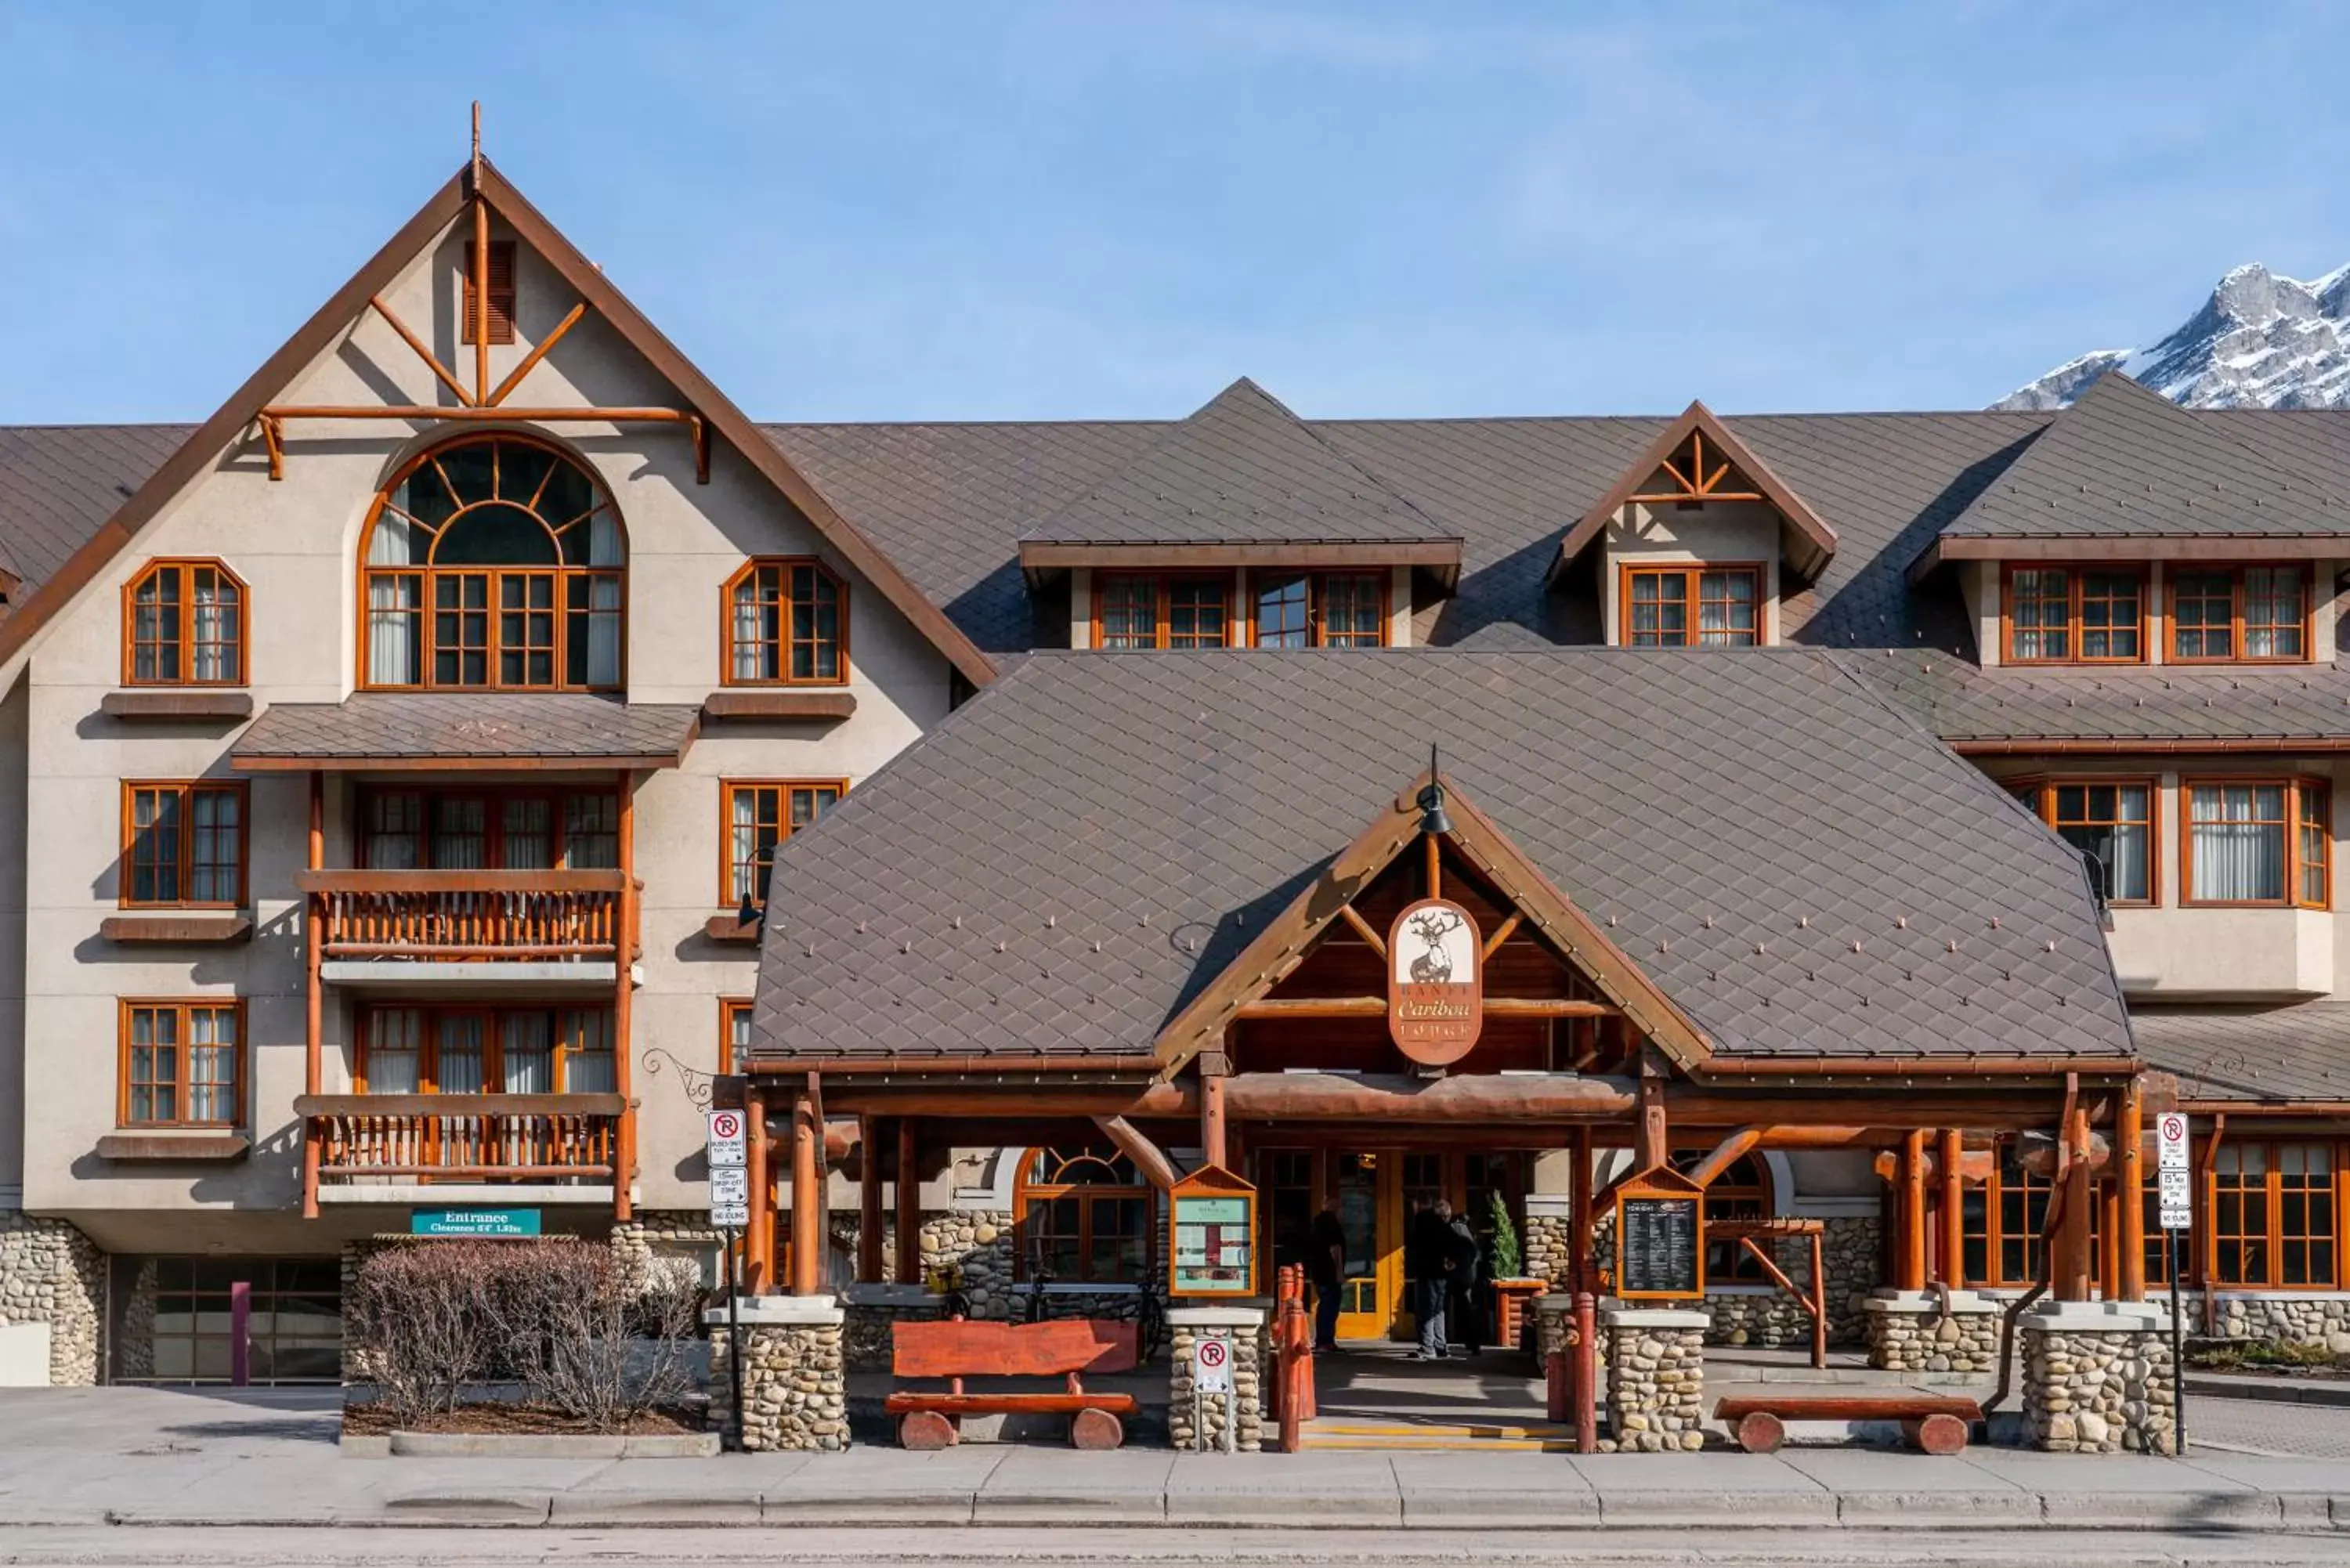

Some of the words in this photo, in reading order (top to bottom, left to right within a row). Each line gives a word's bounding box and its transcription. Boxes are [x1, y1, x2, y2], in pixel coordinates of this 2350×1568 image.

[1397, 998, 1470, 1018] Caribou
[1400, 1022, 1471, 1038] LODGE
[445, 1211, 508, 1223] Entrance
[430, 1223, 475, 1233] Clearance
